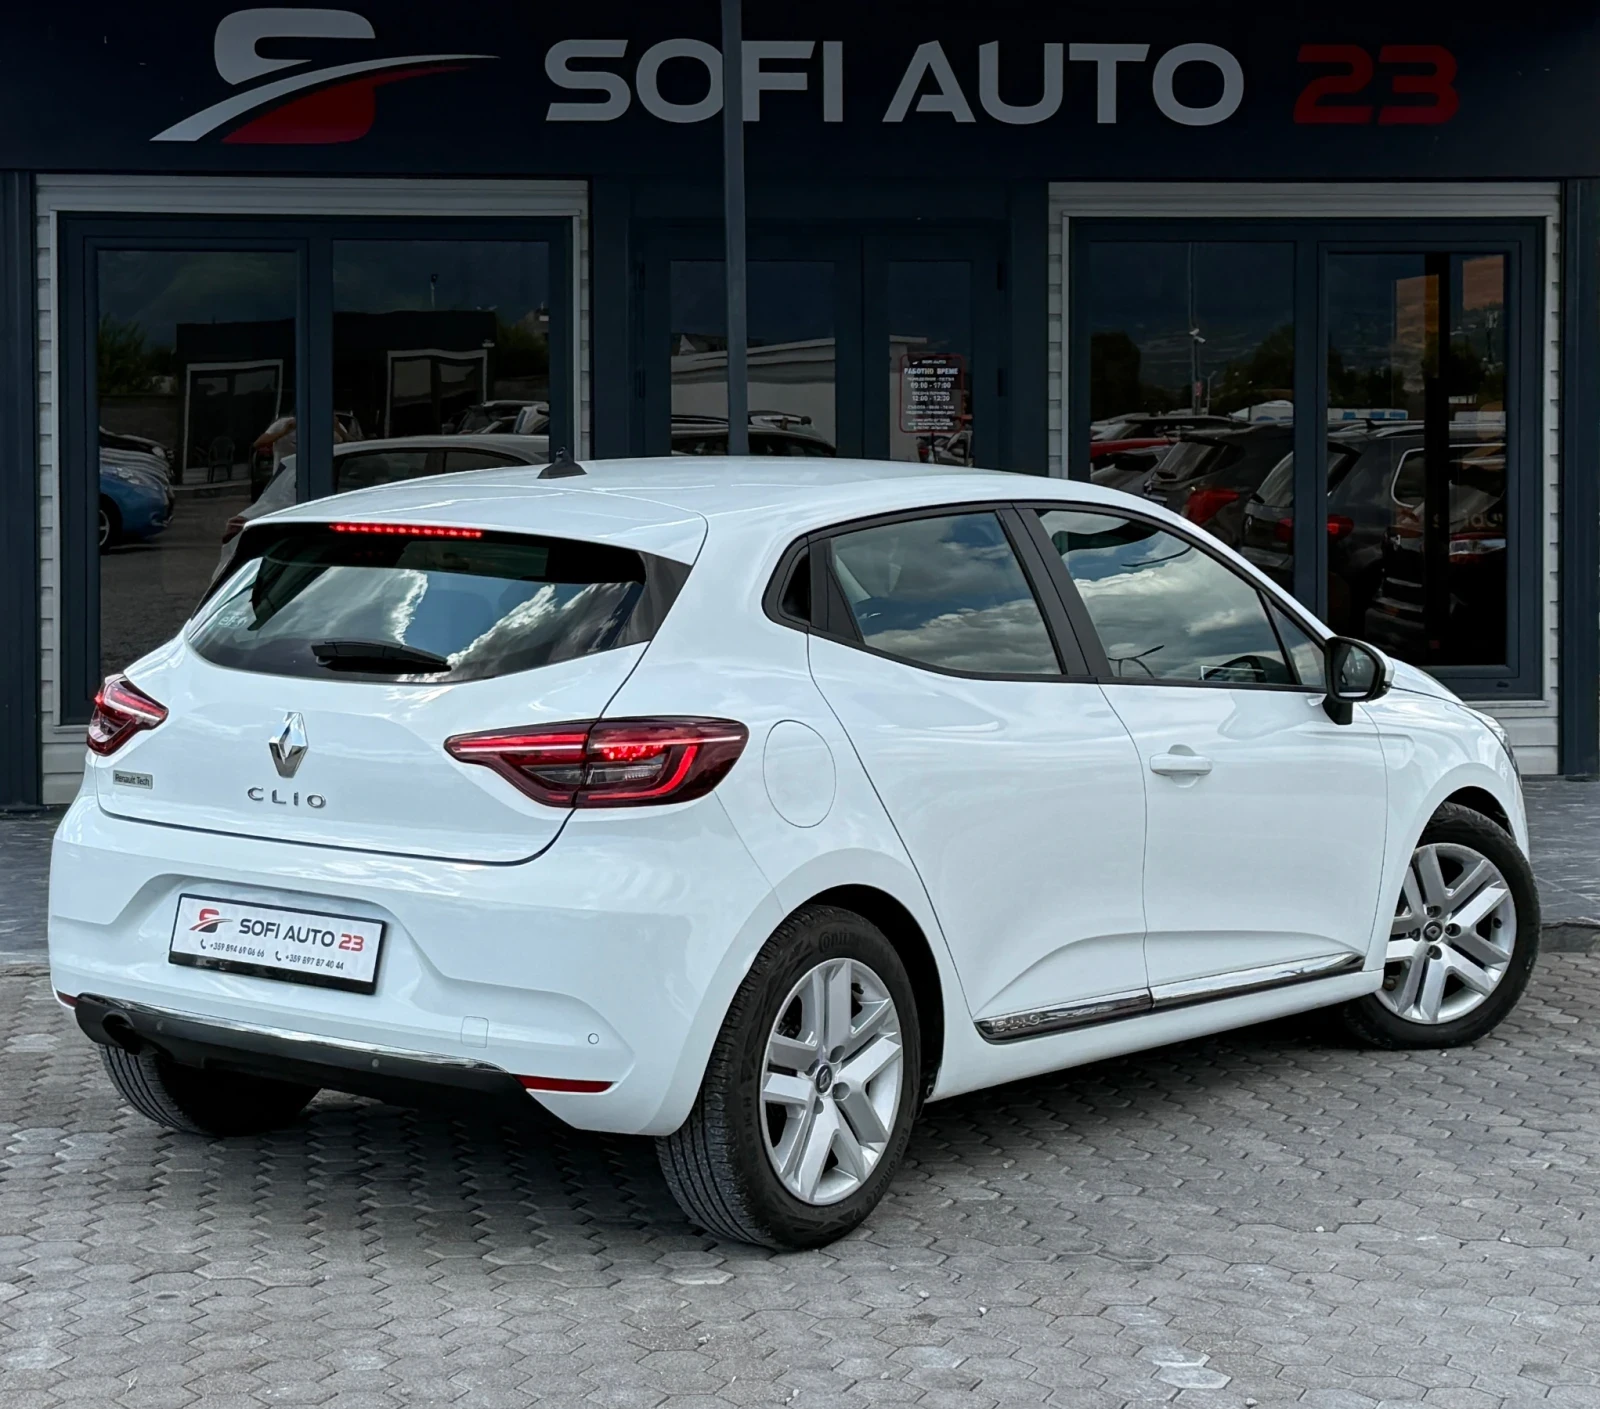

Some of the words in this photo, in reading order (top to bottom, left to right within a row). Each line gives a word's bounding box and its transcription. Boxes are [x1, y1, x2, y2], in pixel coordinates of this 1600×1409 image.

[545, 38, 843, 123] SOFI
[883, 41, 1244, 126] AUTO
[1294, 44, 1459, 126] 23
[904, 367, 934, 375] РАБОТНО
[115, 773, 136, 785] Renault
[136, 776, 150, 786] Tech
[247, 786, 327, 809] CLIO
[239, 918, 281, 939] SOFI
[282, 925, 335, 948] AUTO
[338, 933, 364, 952] 23
[210, 942, 225, 951] +359
[225, 943, 238, 953] 894
[238, 946, 247, 954] 69
[247, 947, 256, 956] 06
[256, 949, 265, 958] 66
[285, 954, 301, 963] +359
[302, 956, 315, 965] 897
[315, 958, 325, 967] 87
[325, 960, 334, 969] 40
[335, 962, 344, 970] 44
